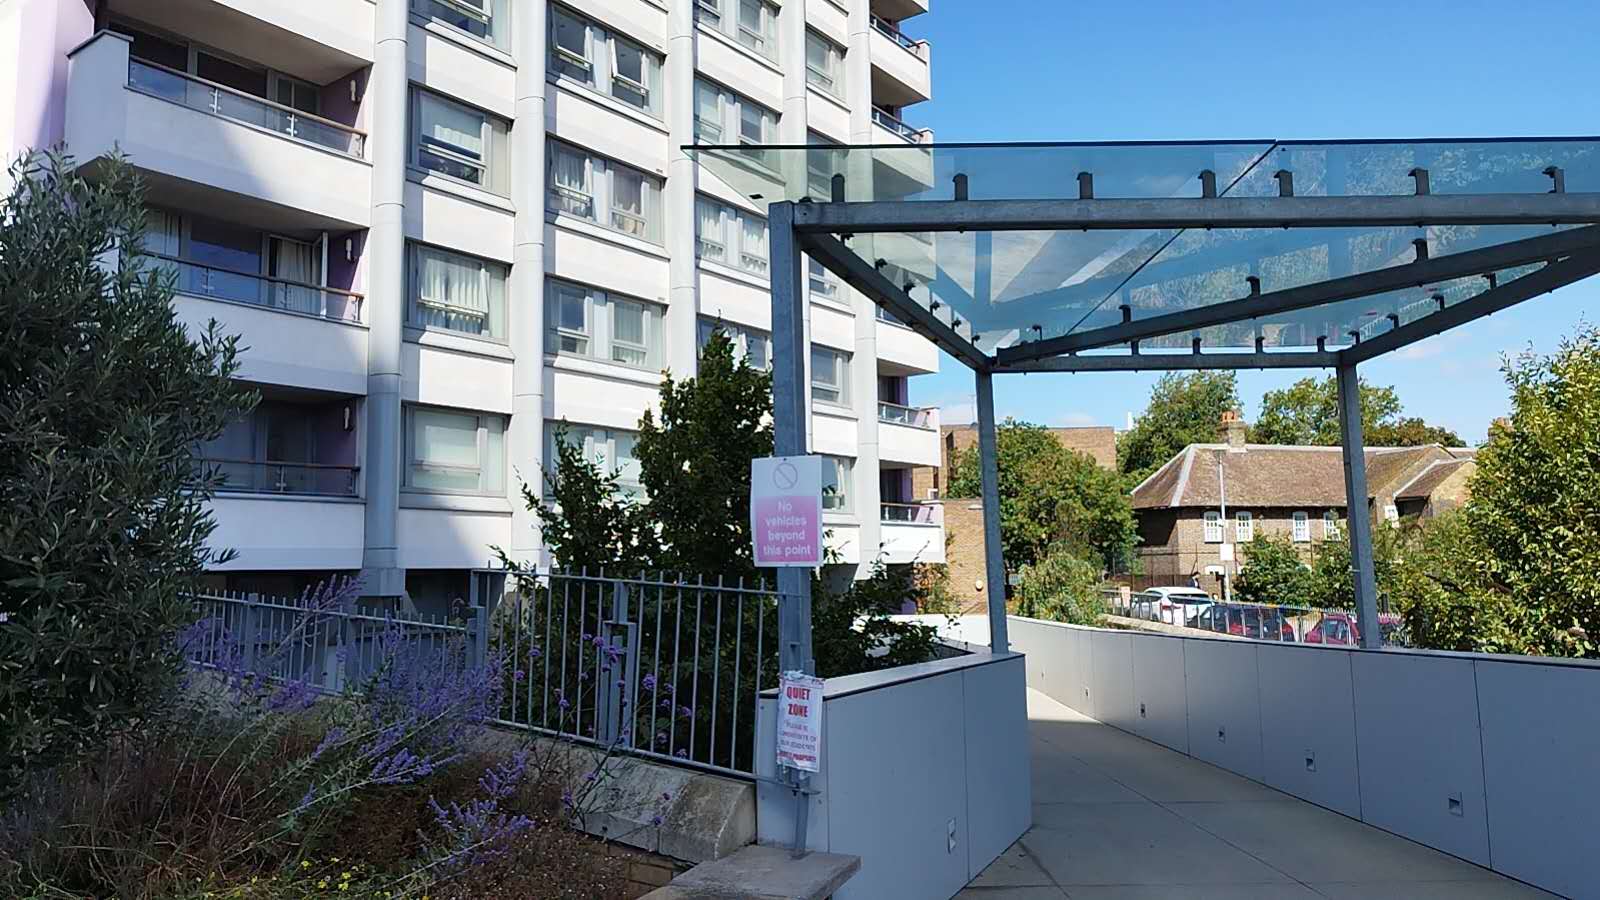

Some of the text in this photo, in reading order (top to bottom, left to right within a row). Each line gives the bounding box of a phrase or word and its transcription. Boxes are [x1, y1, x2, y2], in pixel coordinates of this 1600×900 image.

[778, 502, 792, 512] No
[766, 516, 807, 527] vehicles
[768, 530, 805, 542] beyond
[763, 544, 811, 558] this point
[787, 687, 810, 700] QUIET
[788, 704, 808, 717] ZONE
